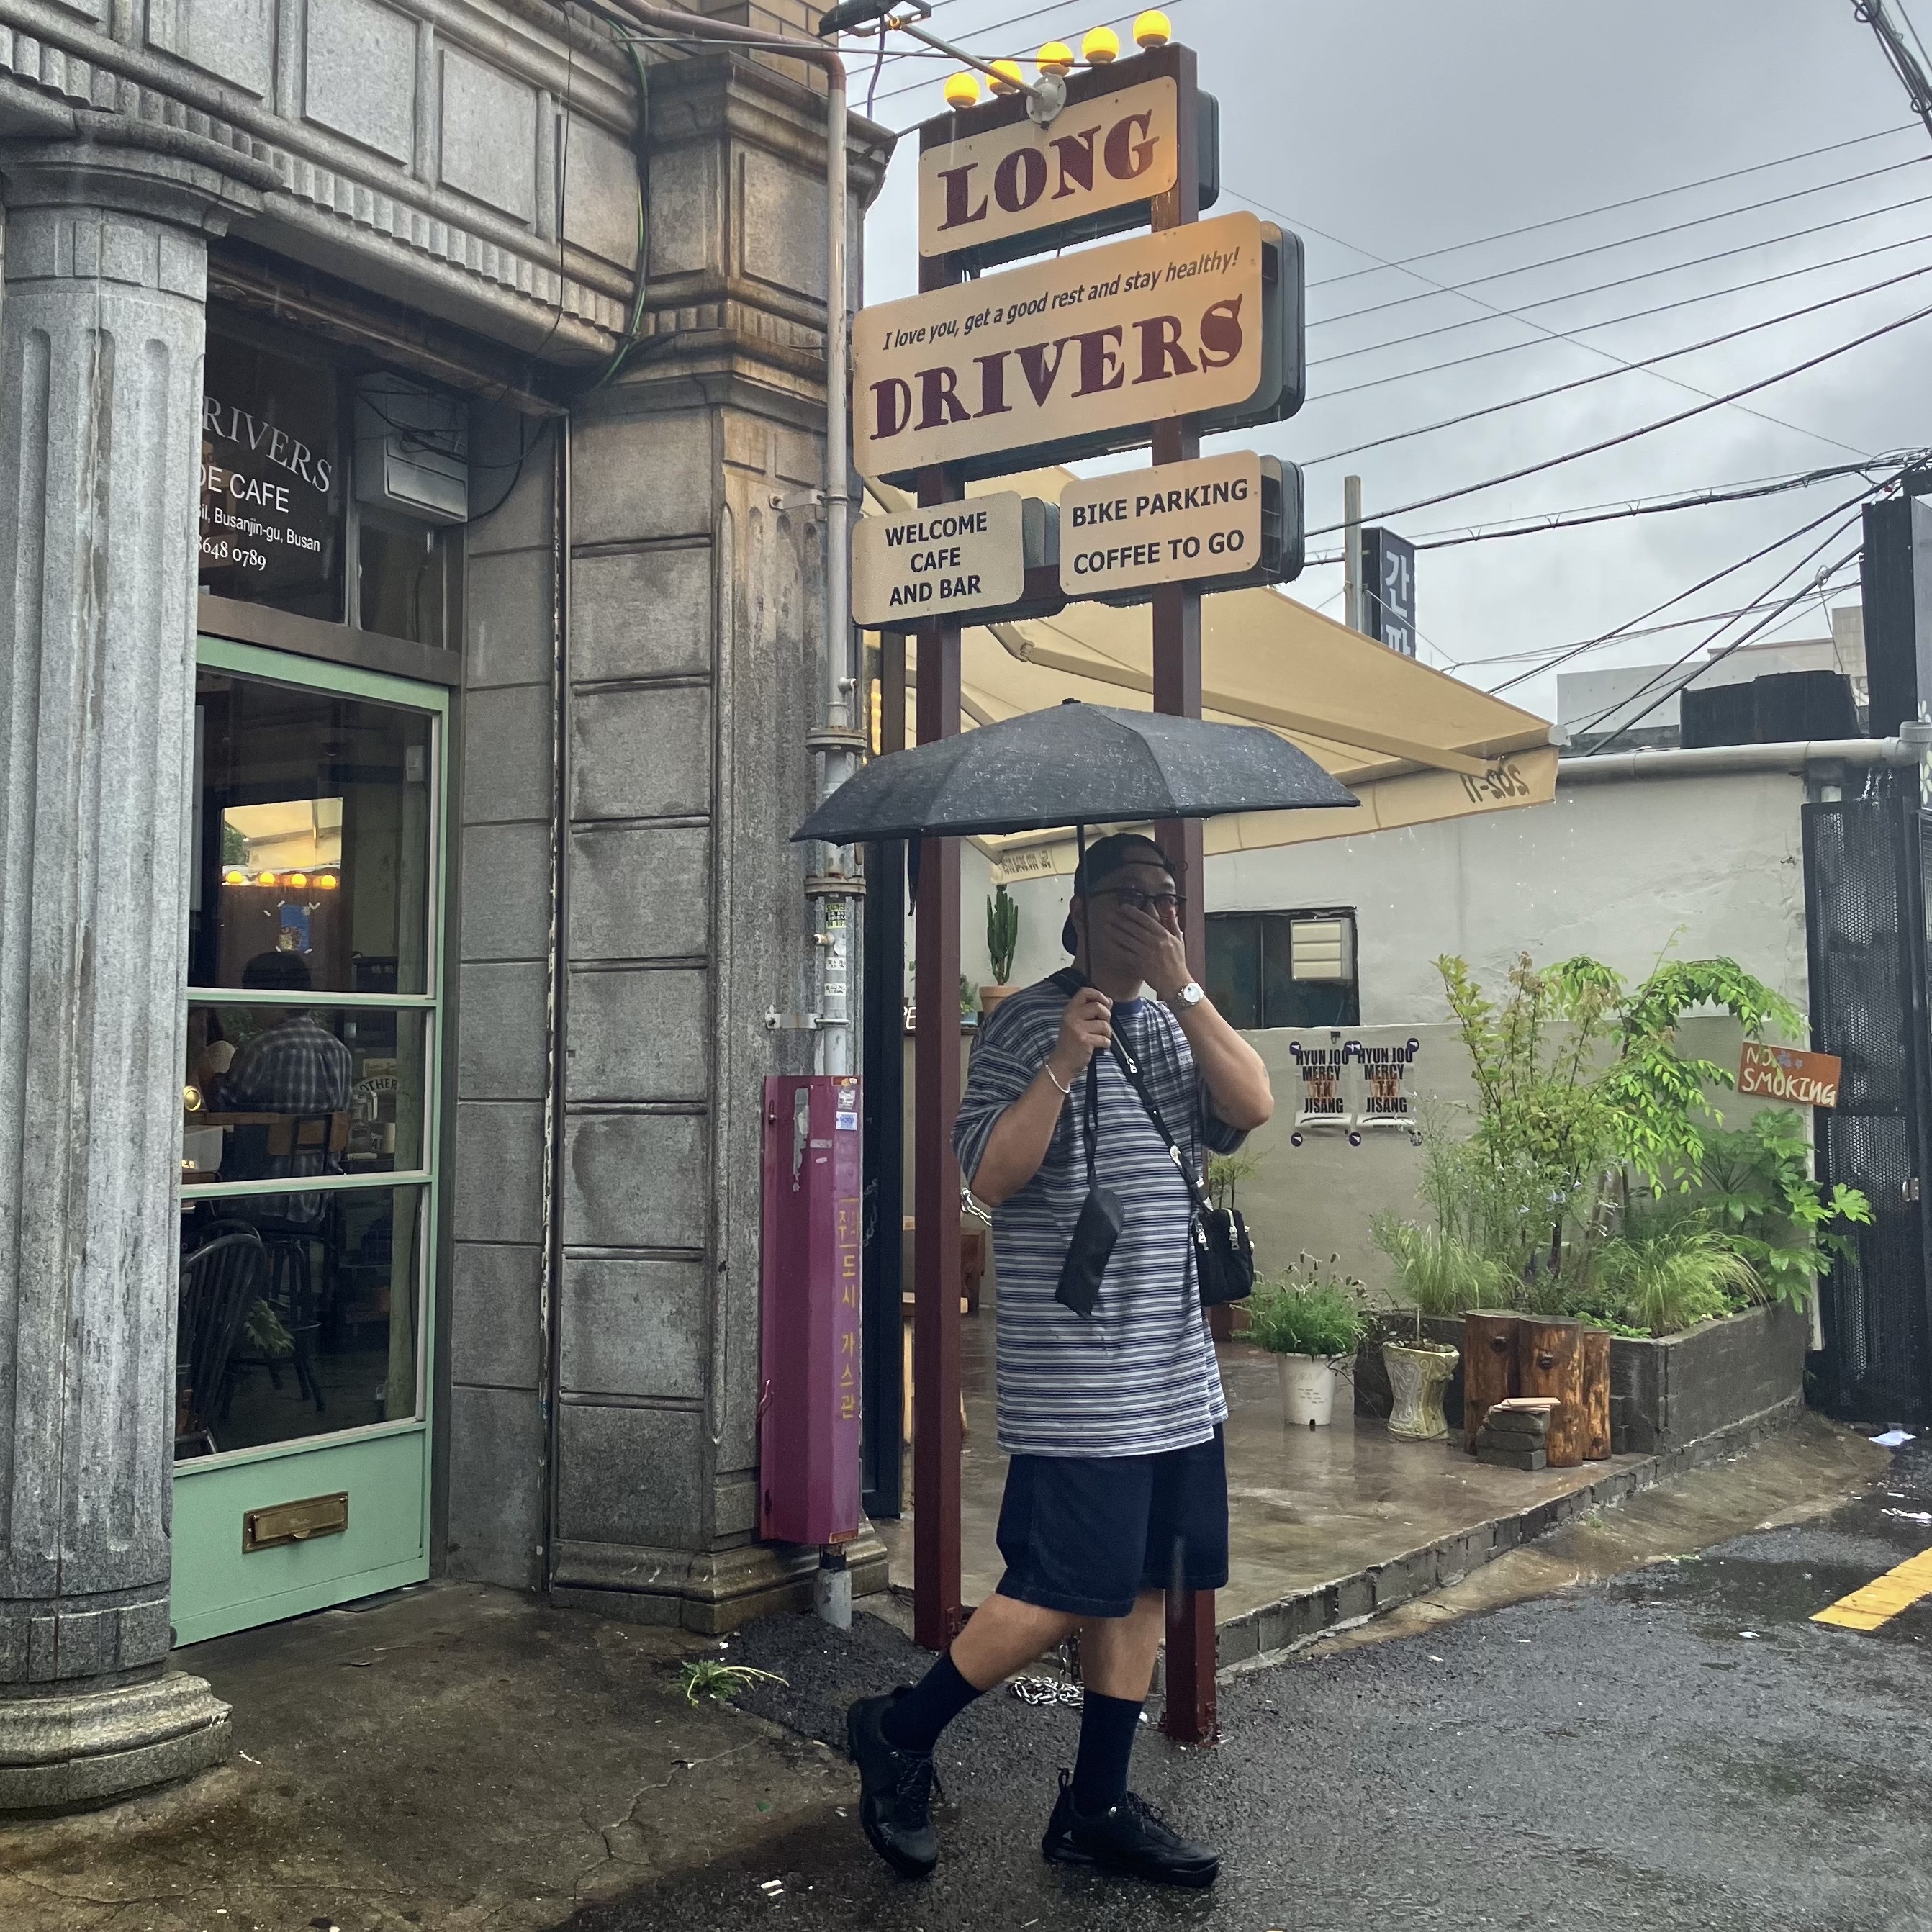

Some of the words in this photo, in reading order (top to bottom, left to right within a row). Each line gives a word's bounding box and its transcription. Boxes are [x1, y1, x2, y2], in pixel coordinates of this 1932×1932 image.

[936, 109, 1160, 232] LONG
[883, 332, 893, 351] I
[894, 328, 926, 348] love
[929, 320, 960, 344] you,
[963, 308, 991, 335] get
[993, 307, 1003, 324] a
[1006, 292, 1049, 325] good
[1051, 284, 1085, 310] rest
[1088, 274, 1121, 300] and
[1124, 268, 1162, 291] stay
[1165, 246, 1240, 283] healthy!
[870, 293, 1243, 441] DRIVERS
[230, 473, 290, 513] CAFE
[1073, 499, 1127, 528] BIKE
[1136, 479, 1247, 518] PARKING
[215, 507, 283, 543] Busanjin-gu,
[286, 528, 321, 552] Busan
[885, 511, 988, 547] WELCOME
[233, 548, 266, 570] 0789
[911, 546, 961, 573] CAFE
[1073, 541, 1160, 574] COFFEE
[1168, 536, 1201, 561] TO
[1208, 529, 1245, 554] GO
[889, 582, 933, 607] AND
[939, 574, 982, 599] BAR
[1296, 1050, 1325, 1065] HYUN
[1329, 1049, 1349, 1065] JOO
[1358, 1048, 1389, 1064] HYUN
[1391, 1047, 1413, 1063] JOO
[1364, 1064, 1404, 1080] MERCY
[1302, 1065, 1340, 1081] MERCY
[1741, 1067, 1836, 1106] SMOKING
[1304, 1098, 1343, 1114] JISANG
[1366, 1097, 1407, 1113] JISANG
